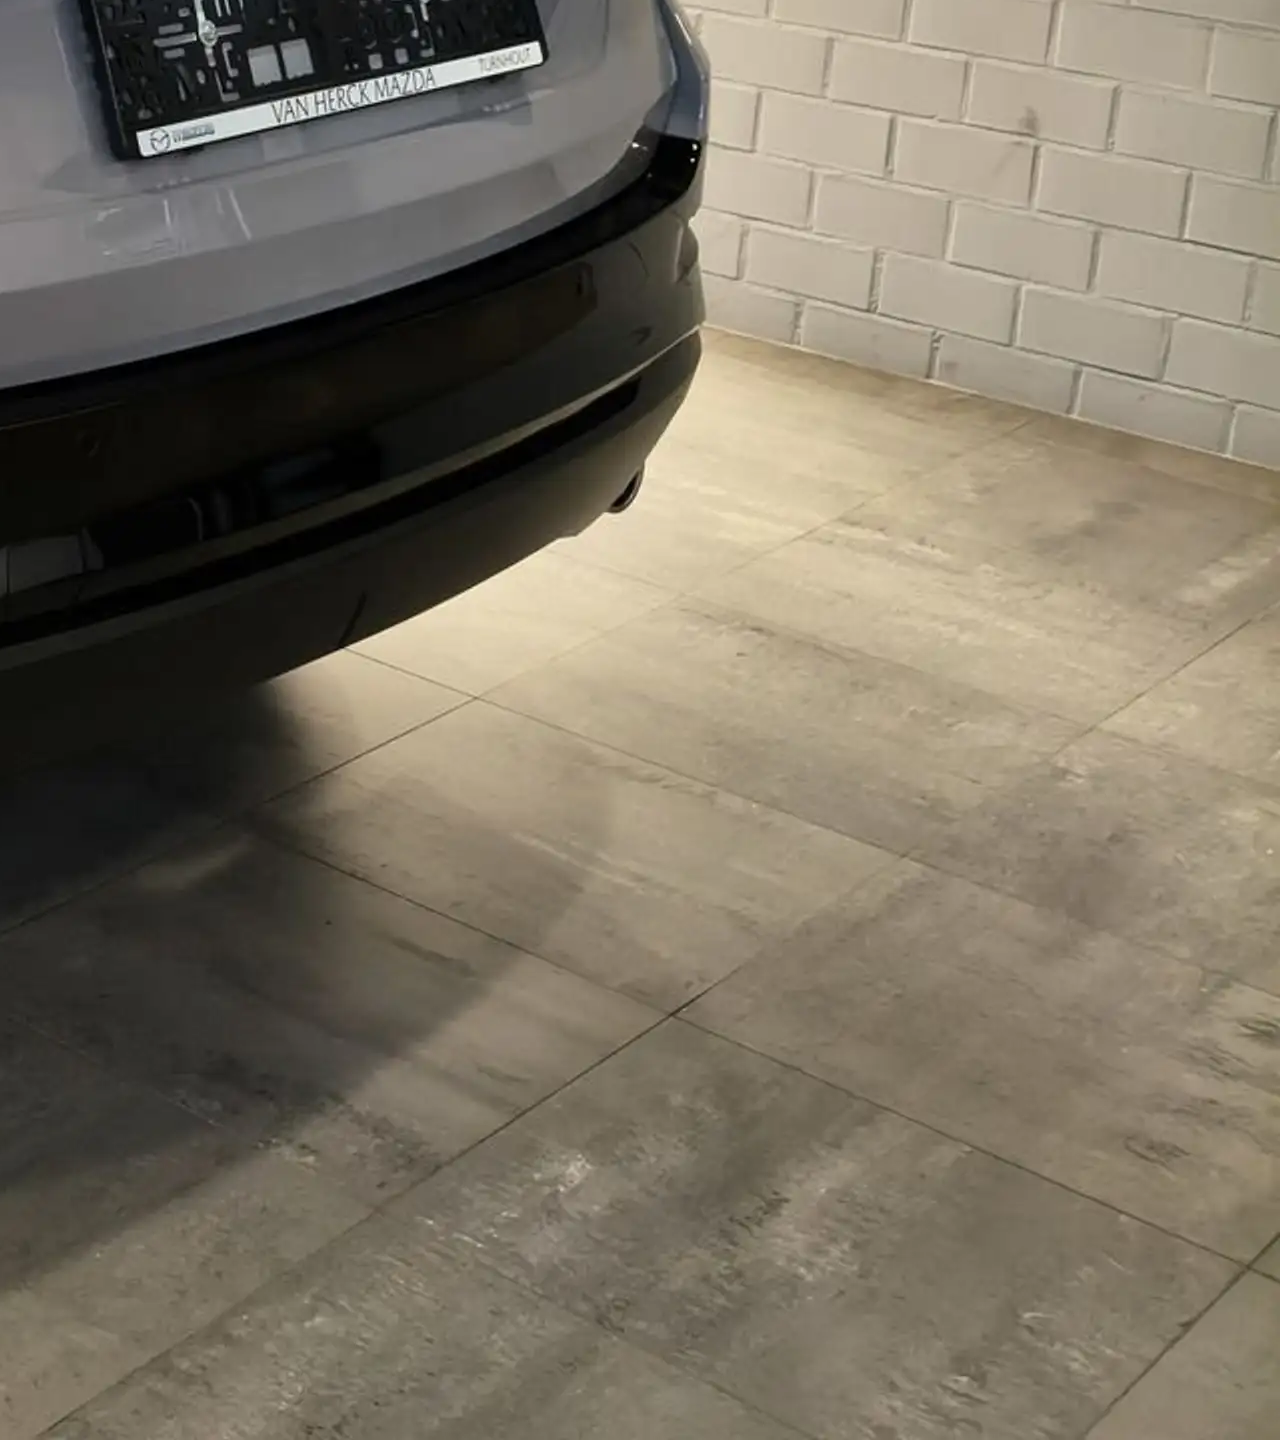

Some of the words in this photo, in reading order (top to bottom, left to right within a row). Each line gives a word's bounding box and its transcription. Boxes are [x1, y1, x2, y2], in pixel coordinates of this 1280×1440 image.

[271, 97, 309, 124] VAN
[314, 82, 370, 113] HERCK
[374, 68, 437, 98] MAZDA
